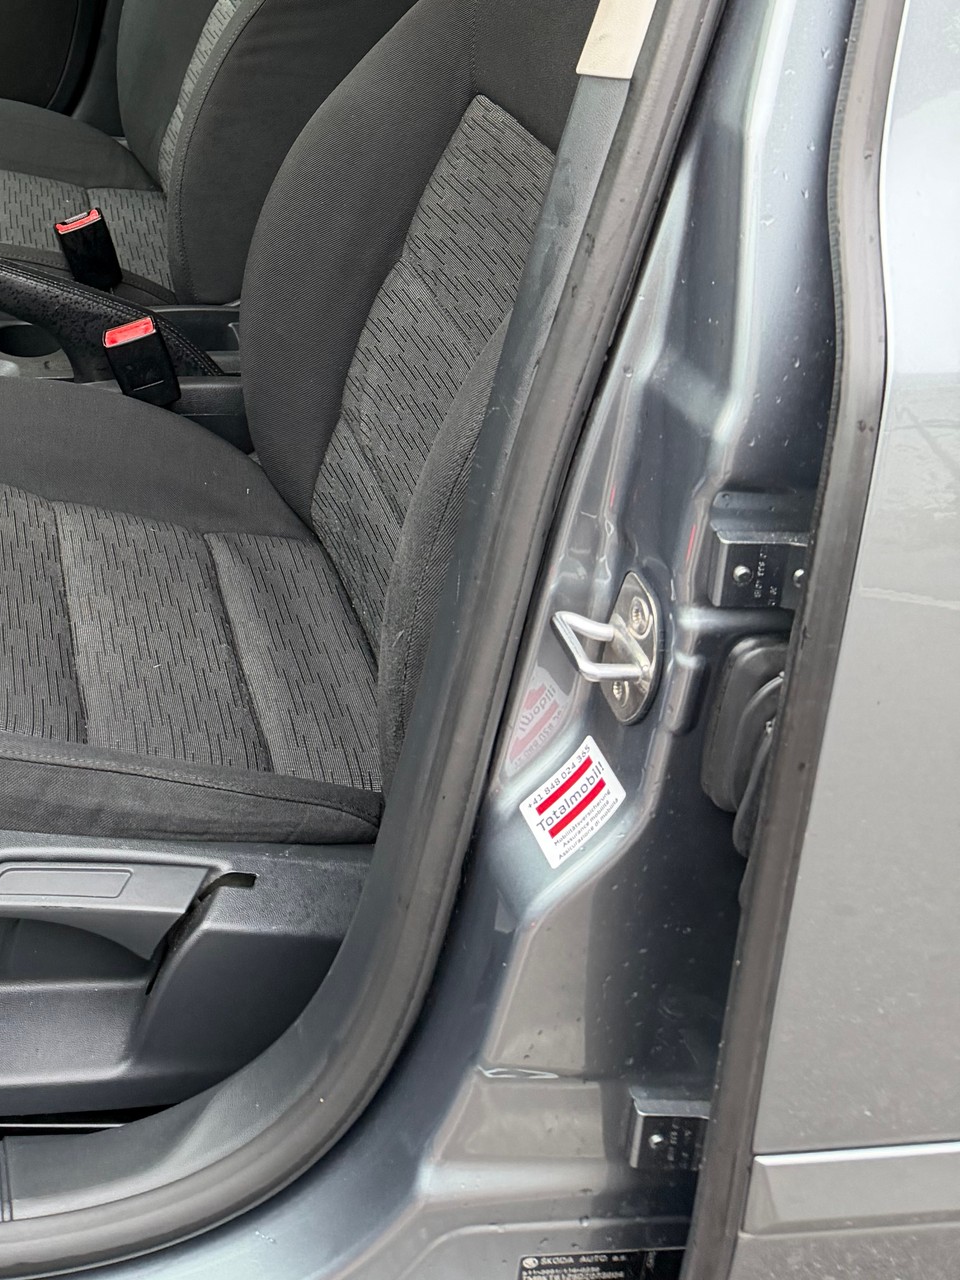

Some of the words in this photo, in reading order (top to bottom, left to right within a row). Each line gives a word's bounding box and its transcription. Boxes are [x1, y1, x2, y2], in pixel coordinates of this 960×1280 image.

[537, 761, 605, 832] Totalmobil!
[544, 778, 561, 795] 848
[561, 762, 577, 779] 024
